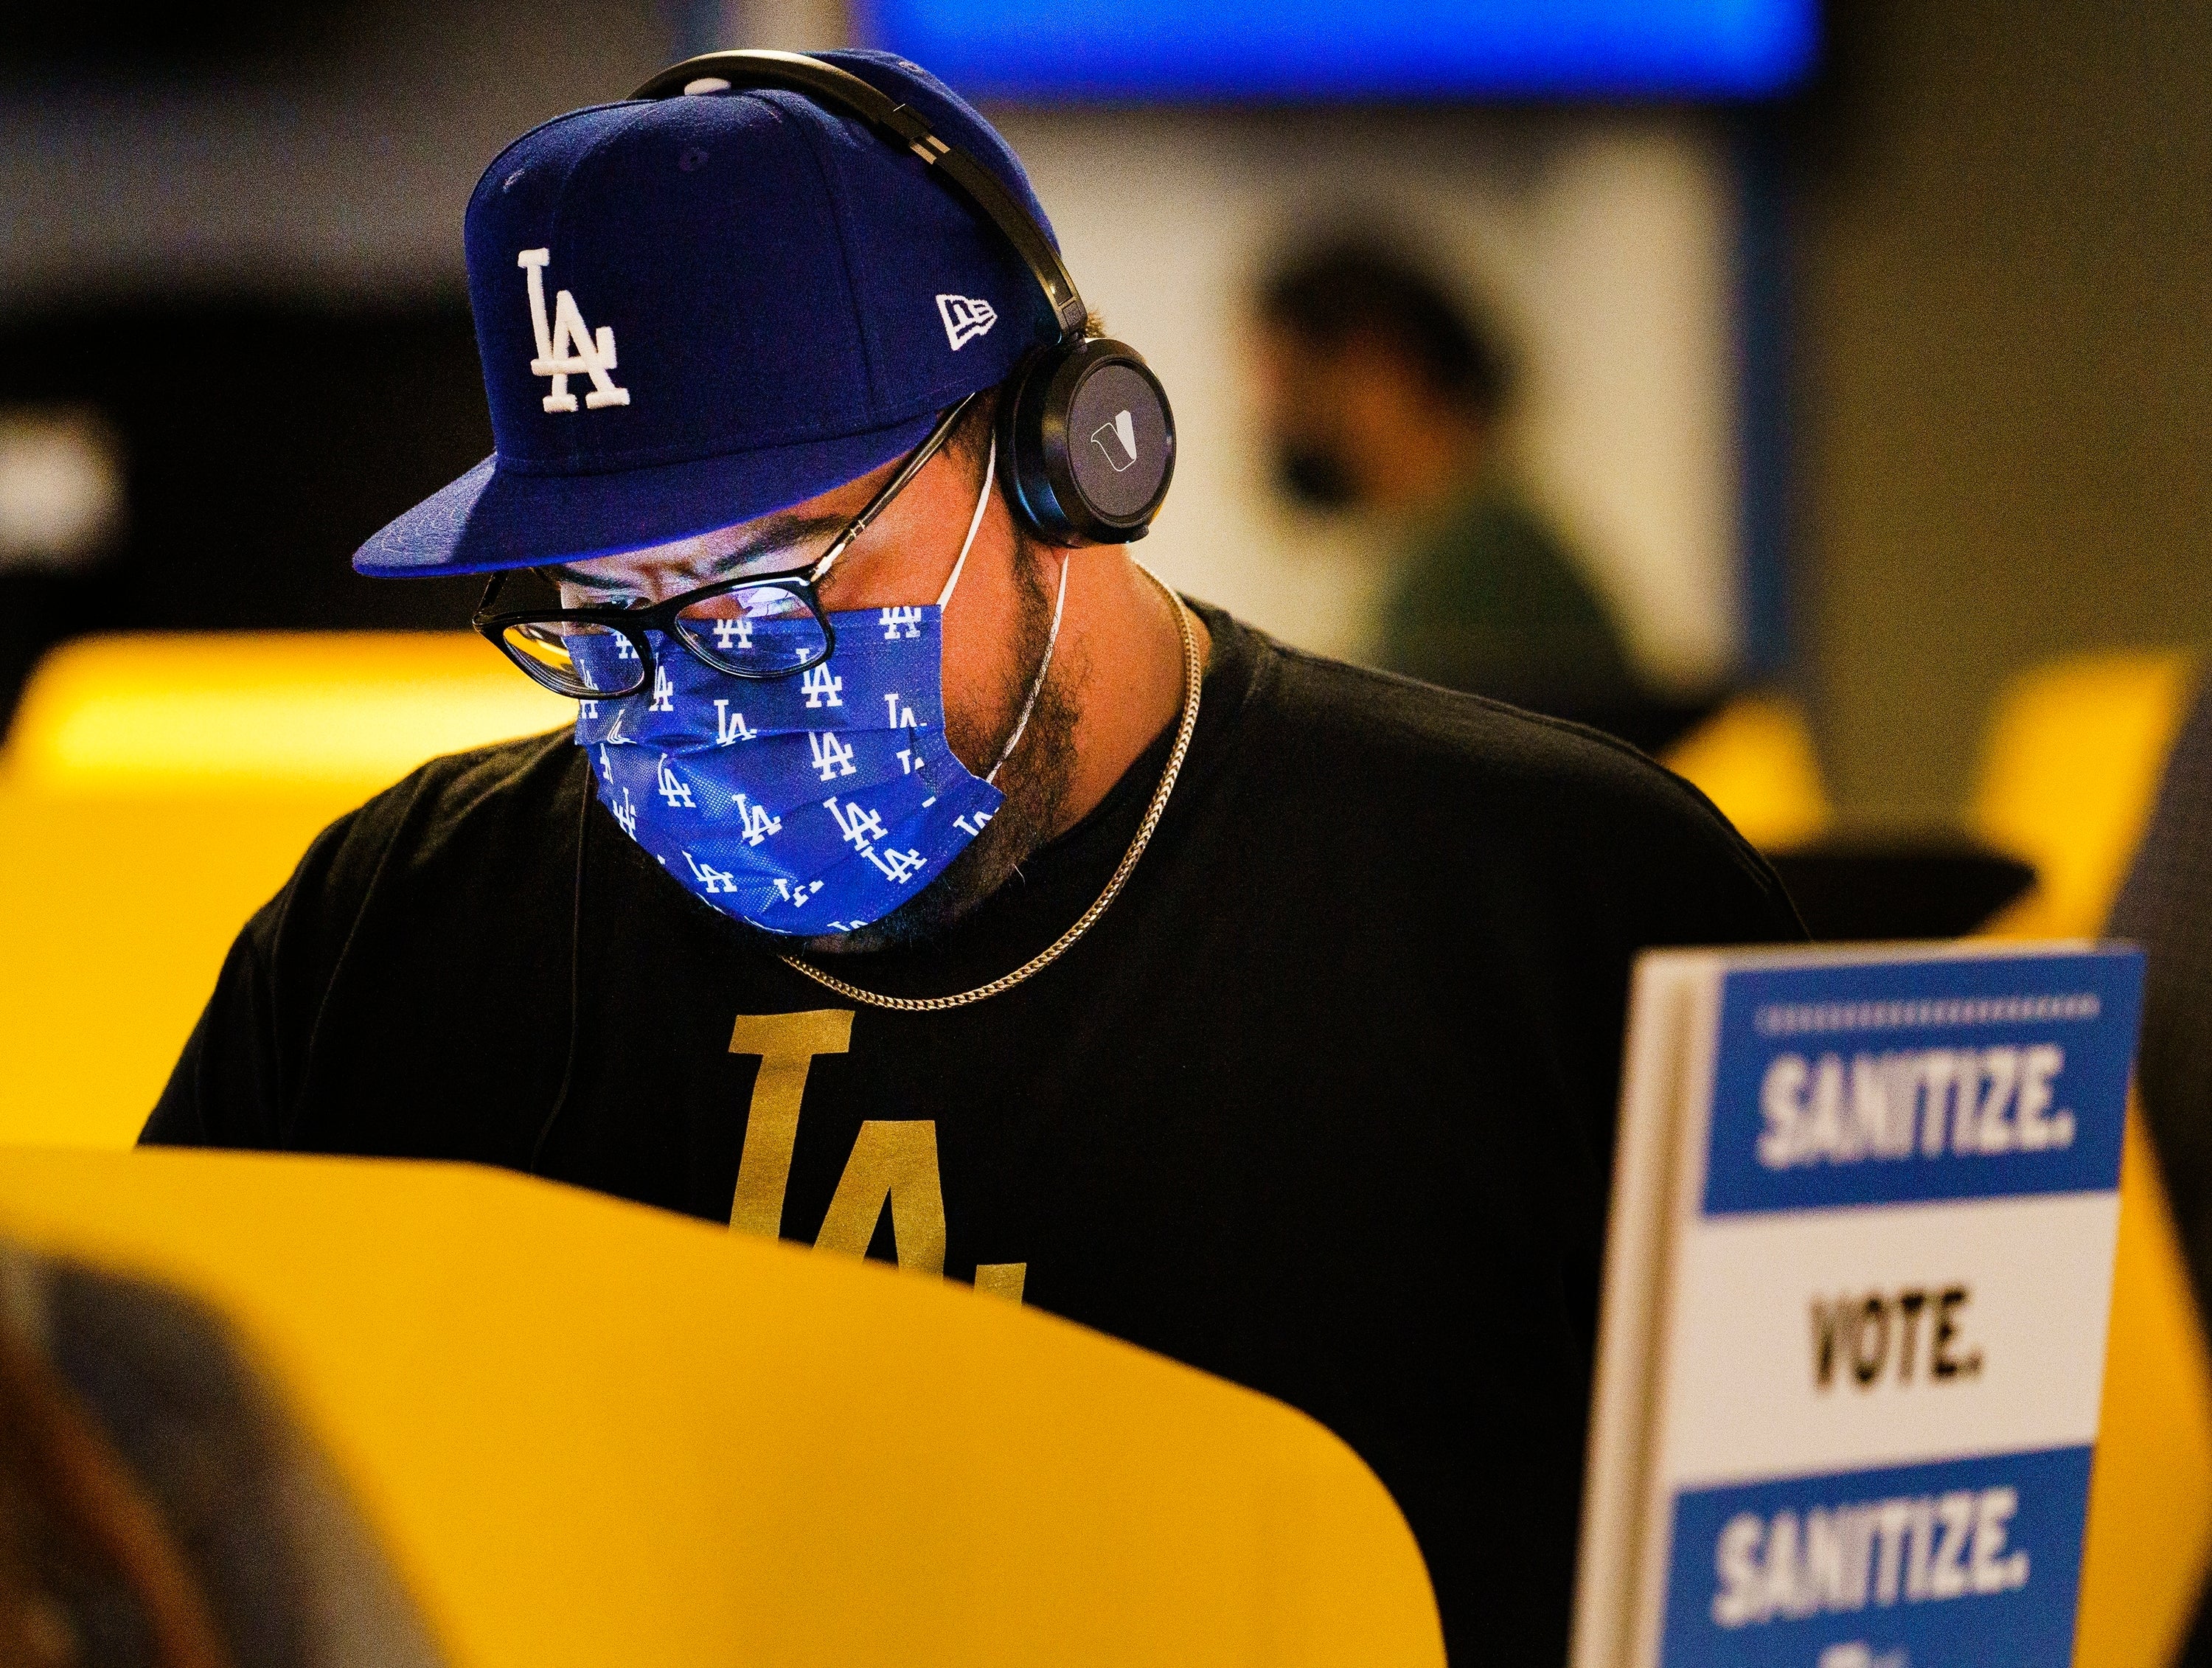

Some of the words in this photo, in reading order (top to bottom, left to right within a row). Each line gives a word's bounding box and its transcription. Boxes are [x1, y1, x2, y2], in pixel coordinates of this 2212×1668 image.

[517, 247, 630, 413] LA
[796, 648, 842, 708] LA
[713, 700, 757, 747] LA
[658, 752, 696, 808] LA
[808, 732, 856, 781] LA
[732, 793, 782, 847] LA
[824, 796, 888, 852] LA
[682, 850, 738, 894] LA
[860, 846, 928, 884] LA
[1757, 1045, 2075, 1168] SANITIZE.
[1810, 1286, 1985, 1389] VOTE.
